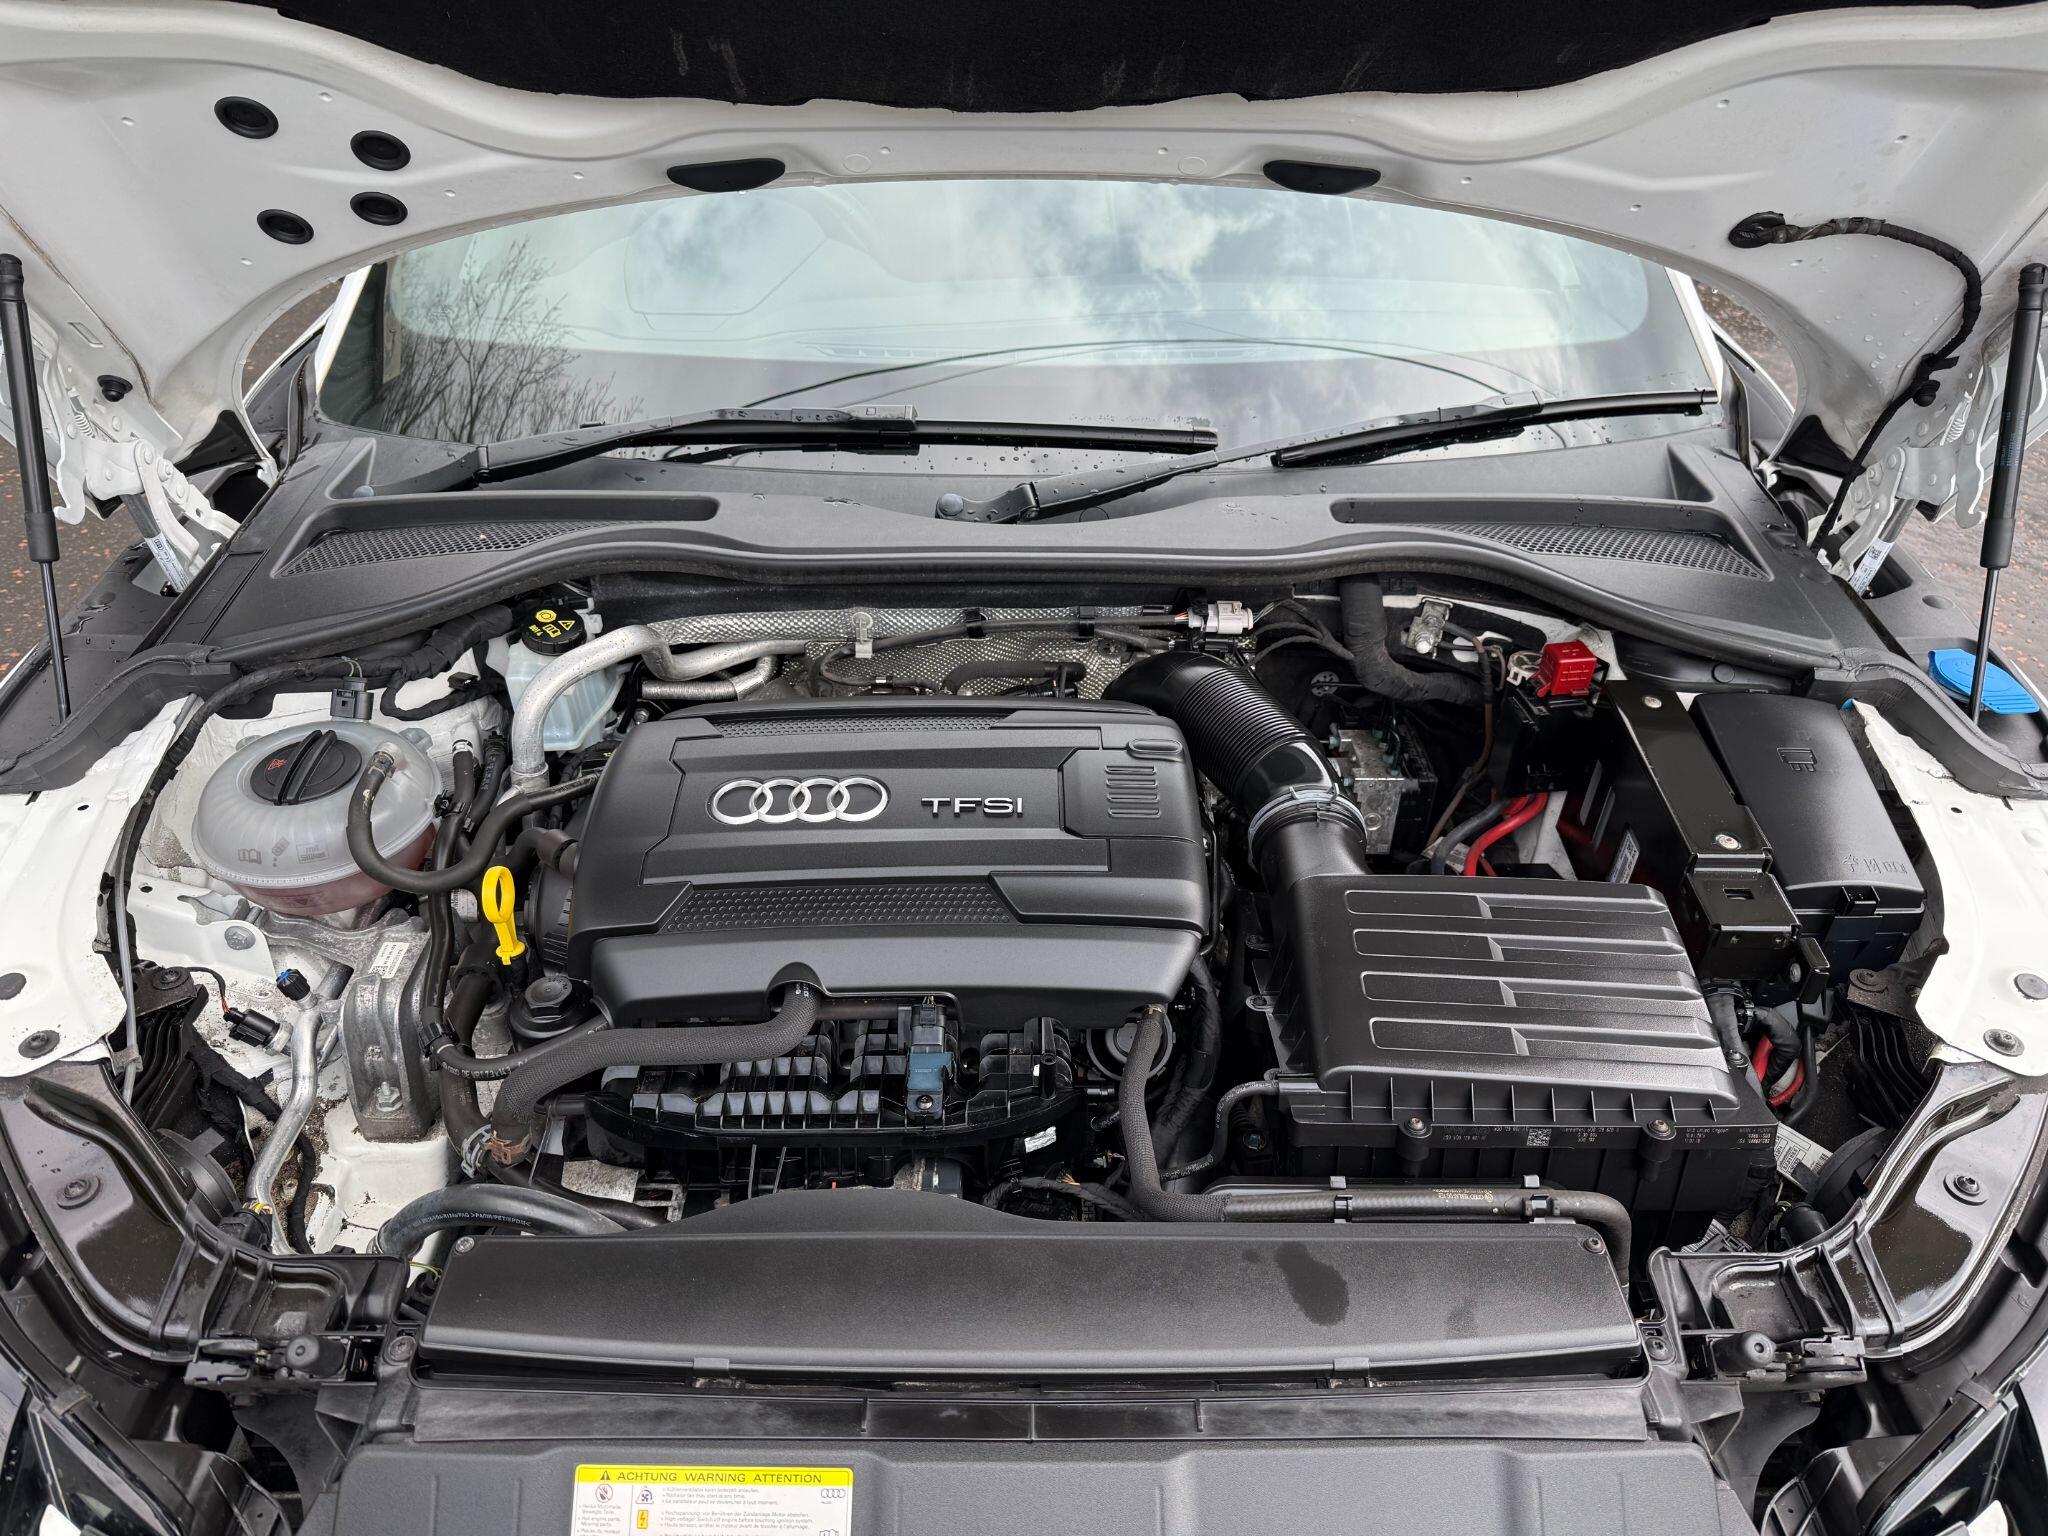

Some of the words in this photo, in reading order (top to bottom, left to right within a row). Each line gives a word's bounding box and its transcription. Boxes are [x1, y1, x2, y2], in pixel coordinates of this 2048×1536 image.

[921, 797, 1023, 818] TFSI
[617, 1472, 677, 1482] ACHTUNG
[685, 1473, 746, 1483] WARNING
[753, 1474, 822, 1484] ATTENTION
